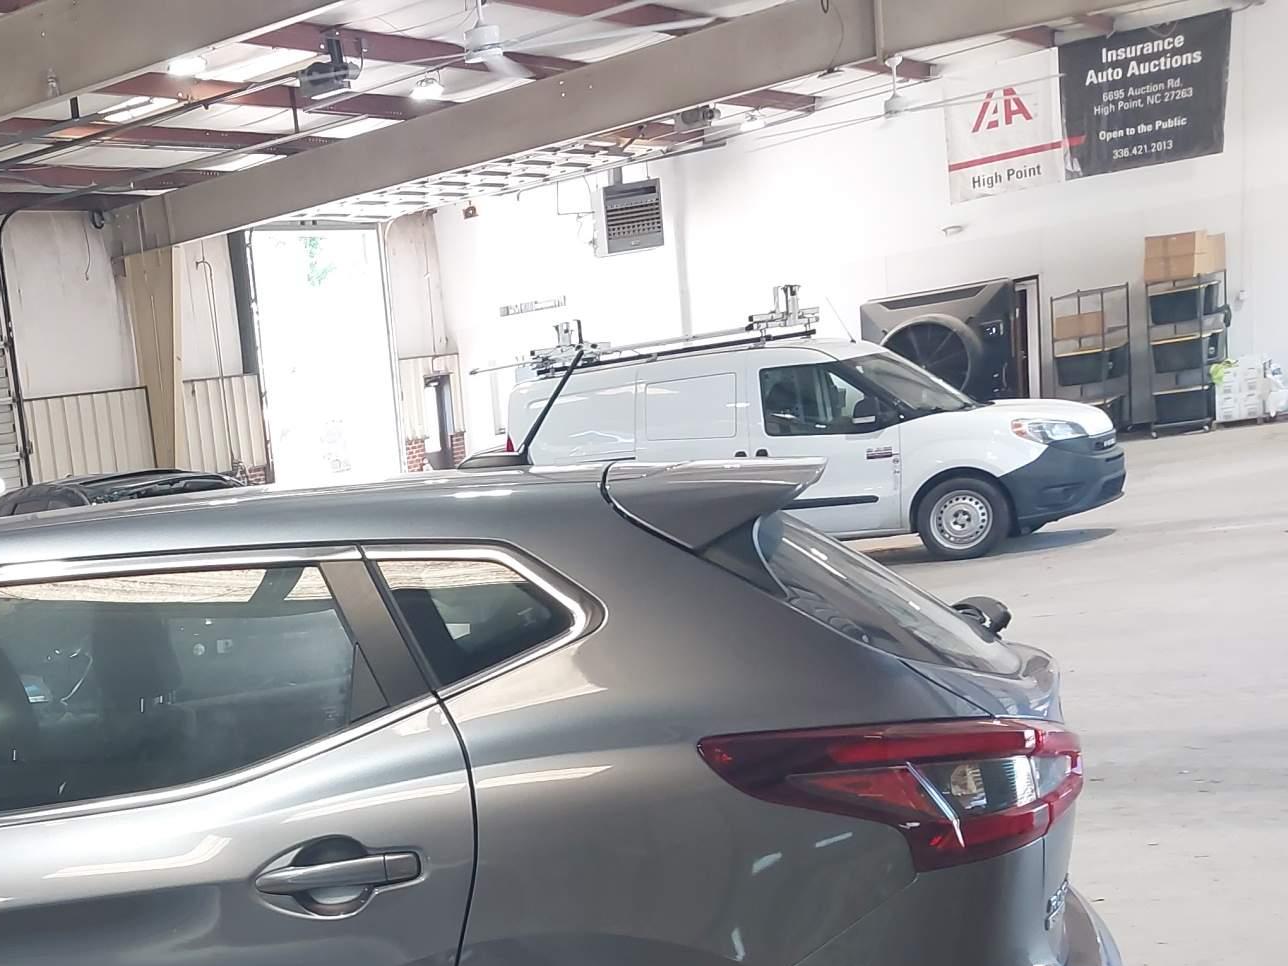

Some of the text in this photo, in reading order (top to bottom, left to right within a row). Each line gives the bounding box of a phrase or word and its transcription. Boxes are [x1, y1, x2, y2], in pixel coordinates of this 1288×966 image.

[1101, 35, 1185, 64] Insurance
[1085, 50, 1203, 86] Auto Auctions
[1093, 86, 1194, 116] High Point, NC 27263
[1102, 77, 1183, 103] 6695 Auction Rd.
[1098, 115, 1188, 142] Open to the Public
[1112, 138, 1174, 160] 336.421.2013
[971, 164, 1042, 189] High Point
